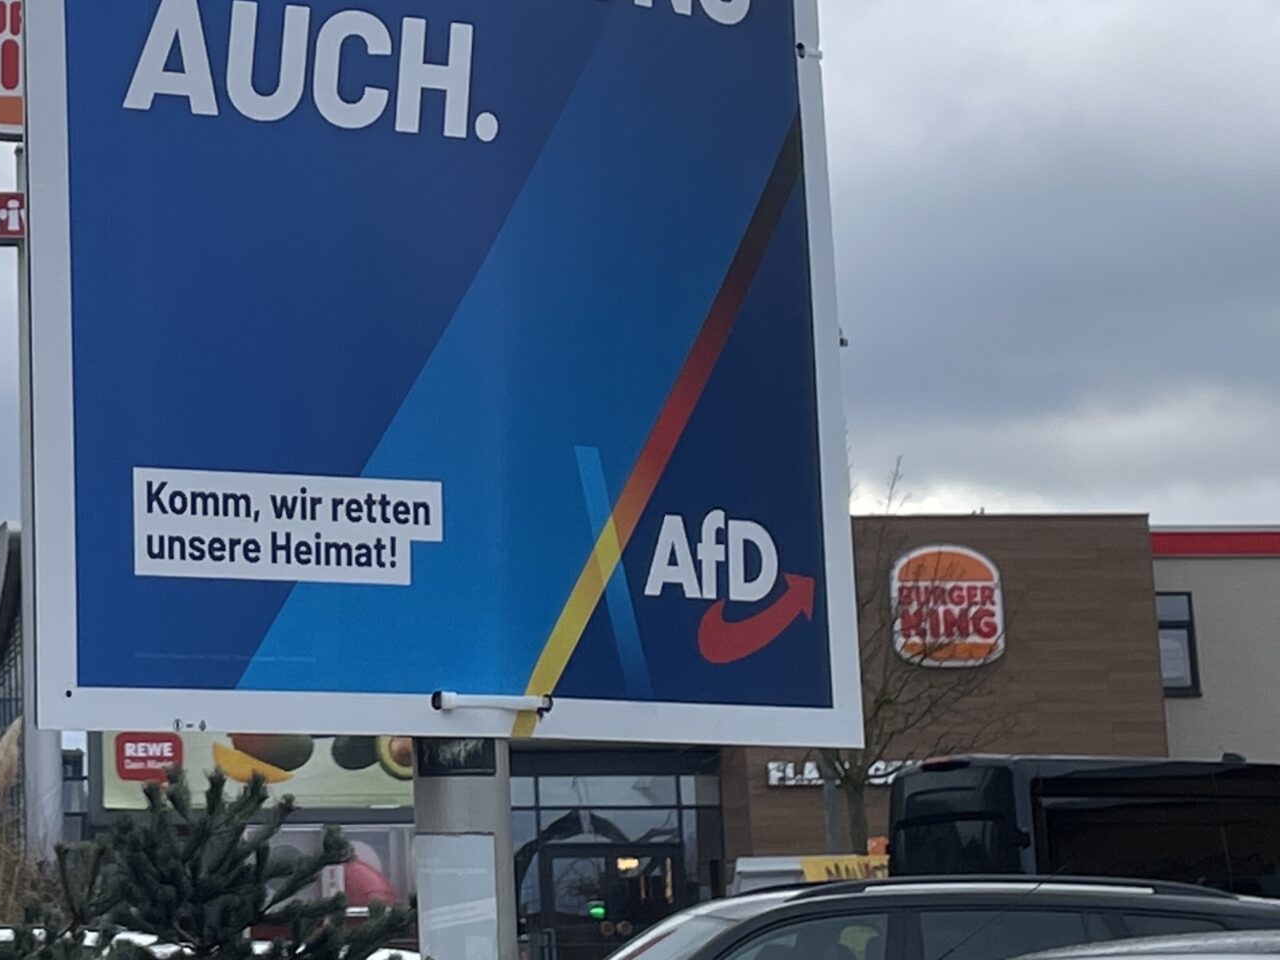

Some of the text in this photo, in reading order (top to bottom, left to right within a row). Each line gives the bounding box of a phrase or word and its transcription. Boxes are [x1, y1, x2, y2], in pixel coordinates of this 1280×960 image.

[146, 480, 431, 526] Komm, wir retten
[146, 531, 397, 569] unsere Heimat!
[644, 509, 778, 602] AfD
[898, 585, 996, 606] BURGER
[900, 607, 998, 639] KING
[124, 742, 174, 757] REWE
